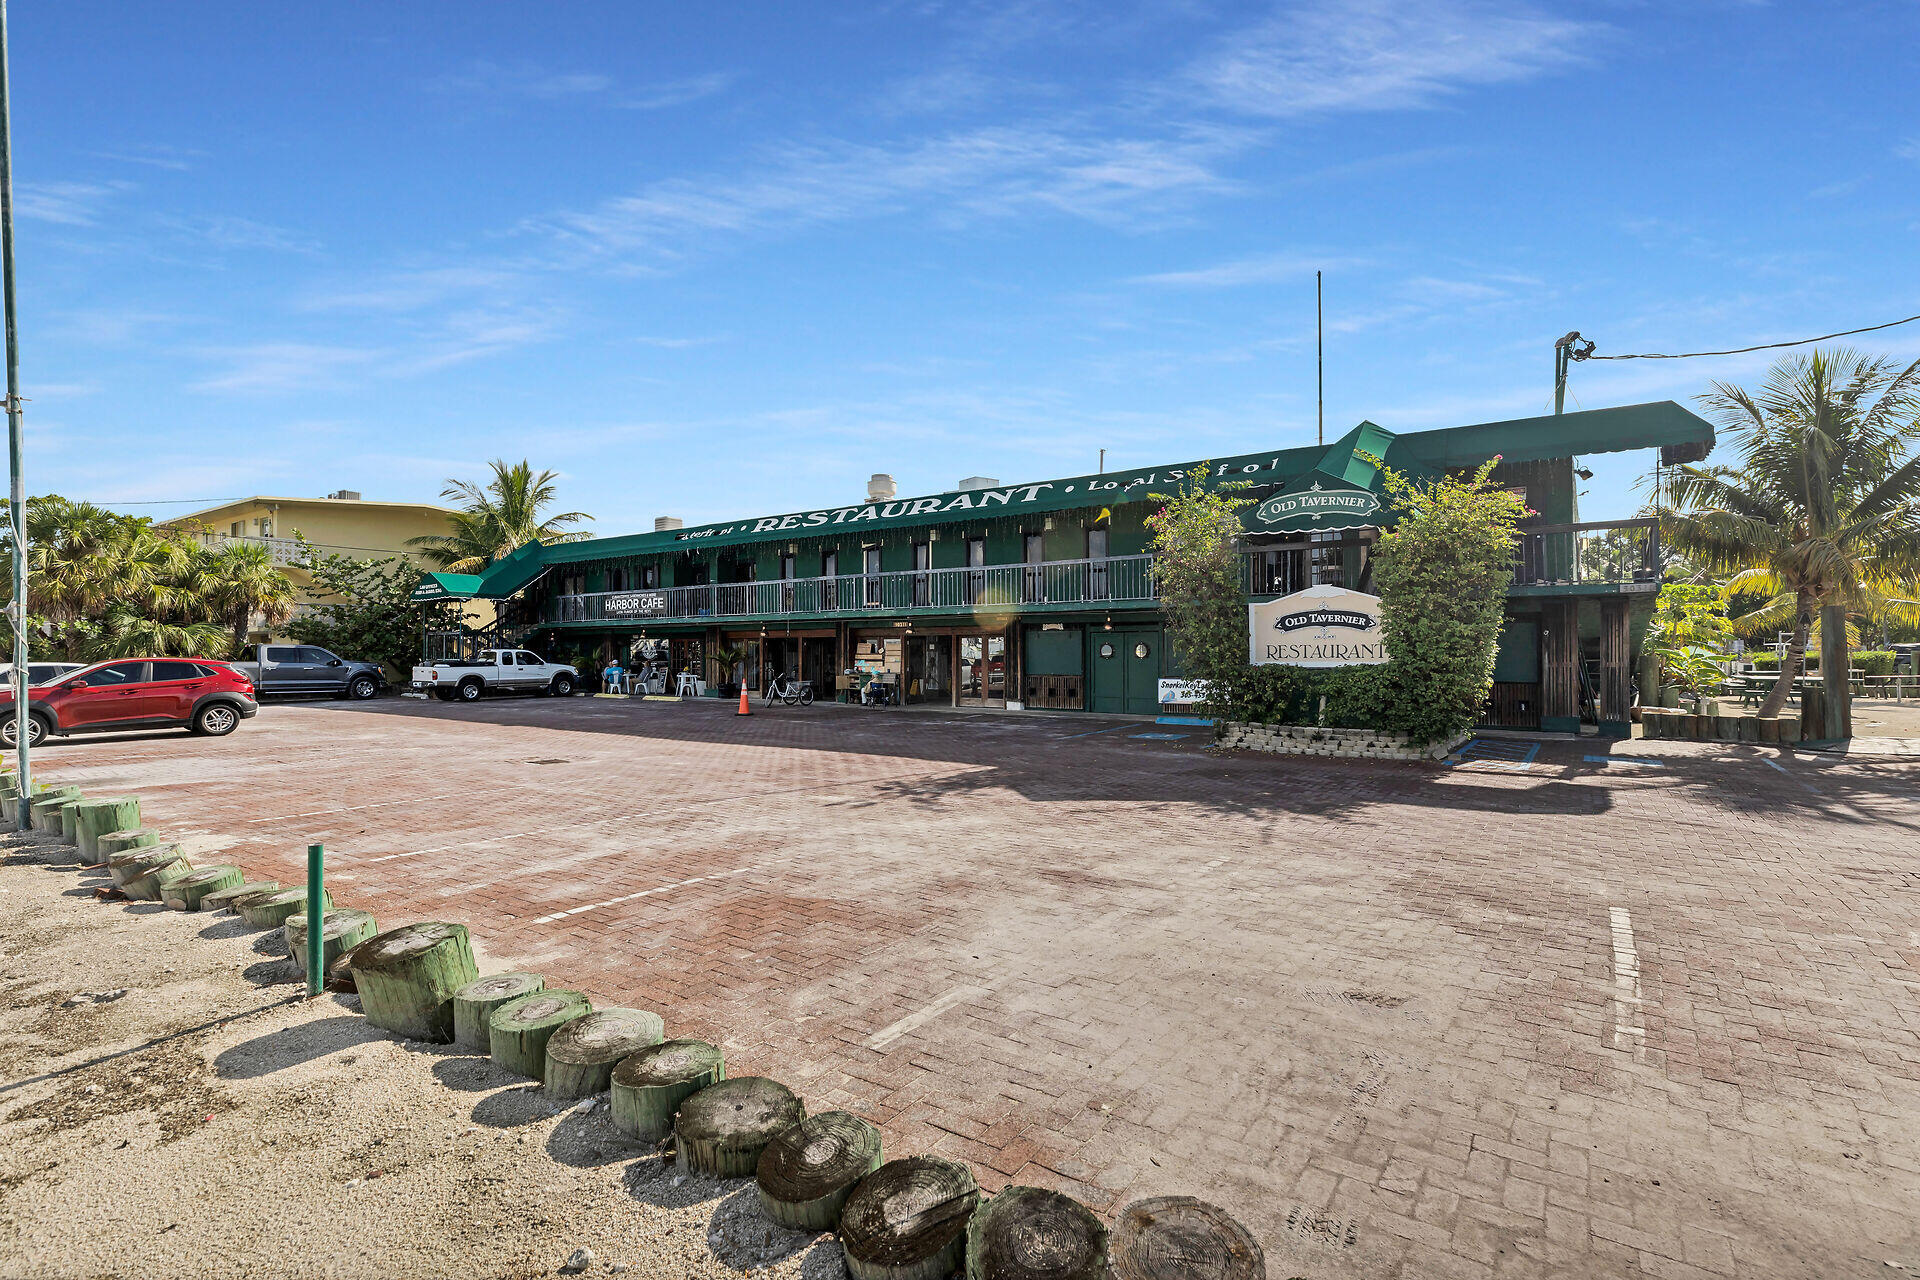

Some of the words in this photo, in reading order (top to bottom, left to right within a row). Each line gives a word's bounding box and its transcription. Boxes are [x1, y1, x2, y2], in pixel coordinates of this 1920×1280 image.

[750, 483, 1053, 533] RESTAURANT
[1088, 473, 1156, 493] Loal
[1271, 501, 1297, 514] OLD
[1299, 496, 1365, 508] TAVERNIER
[605, 599, 639, 610] HARBOR
[641, 597, 664, 608] CAFE
[1285, 616, 1307, 627] OLD
[1309, 613, 1366, 625] TAVERNIER
[1266, 644, 1385, 660] RESTAURANT
